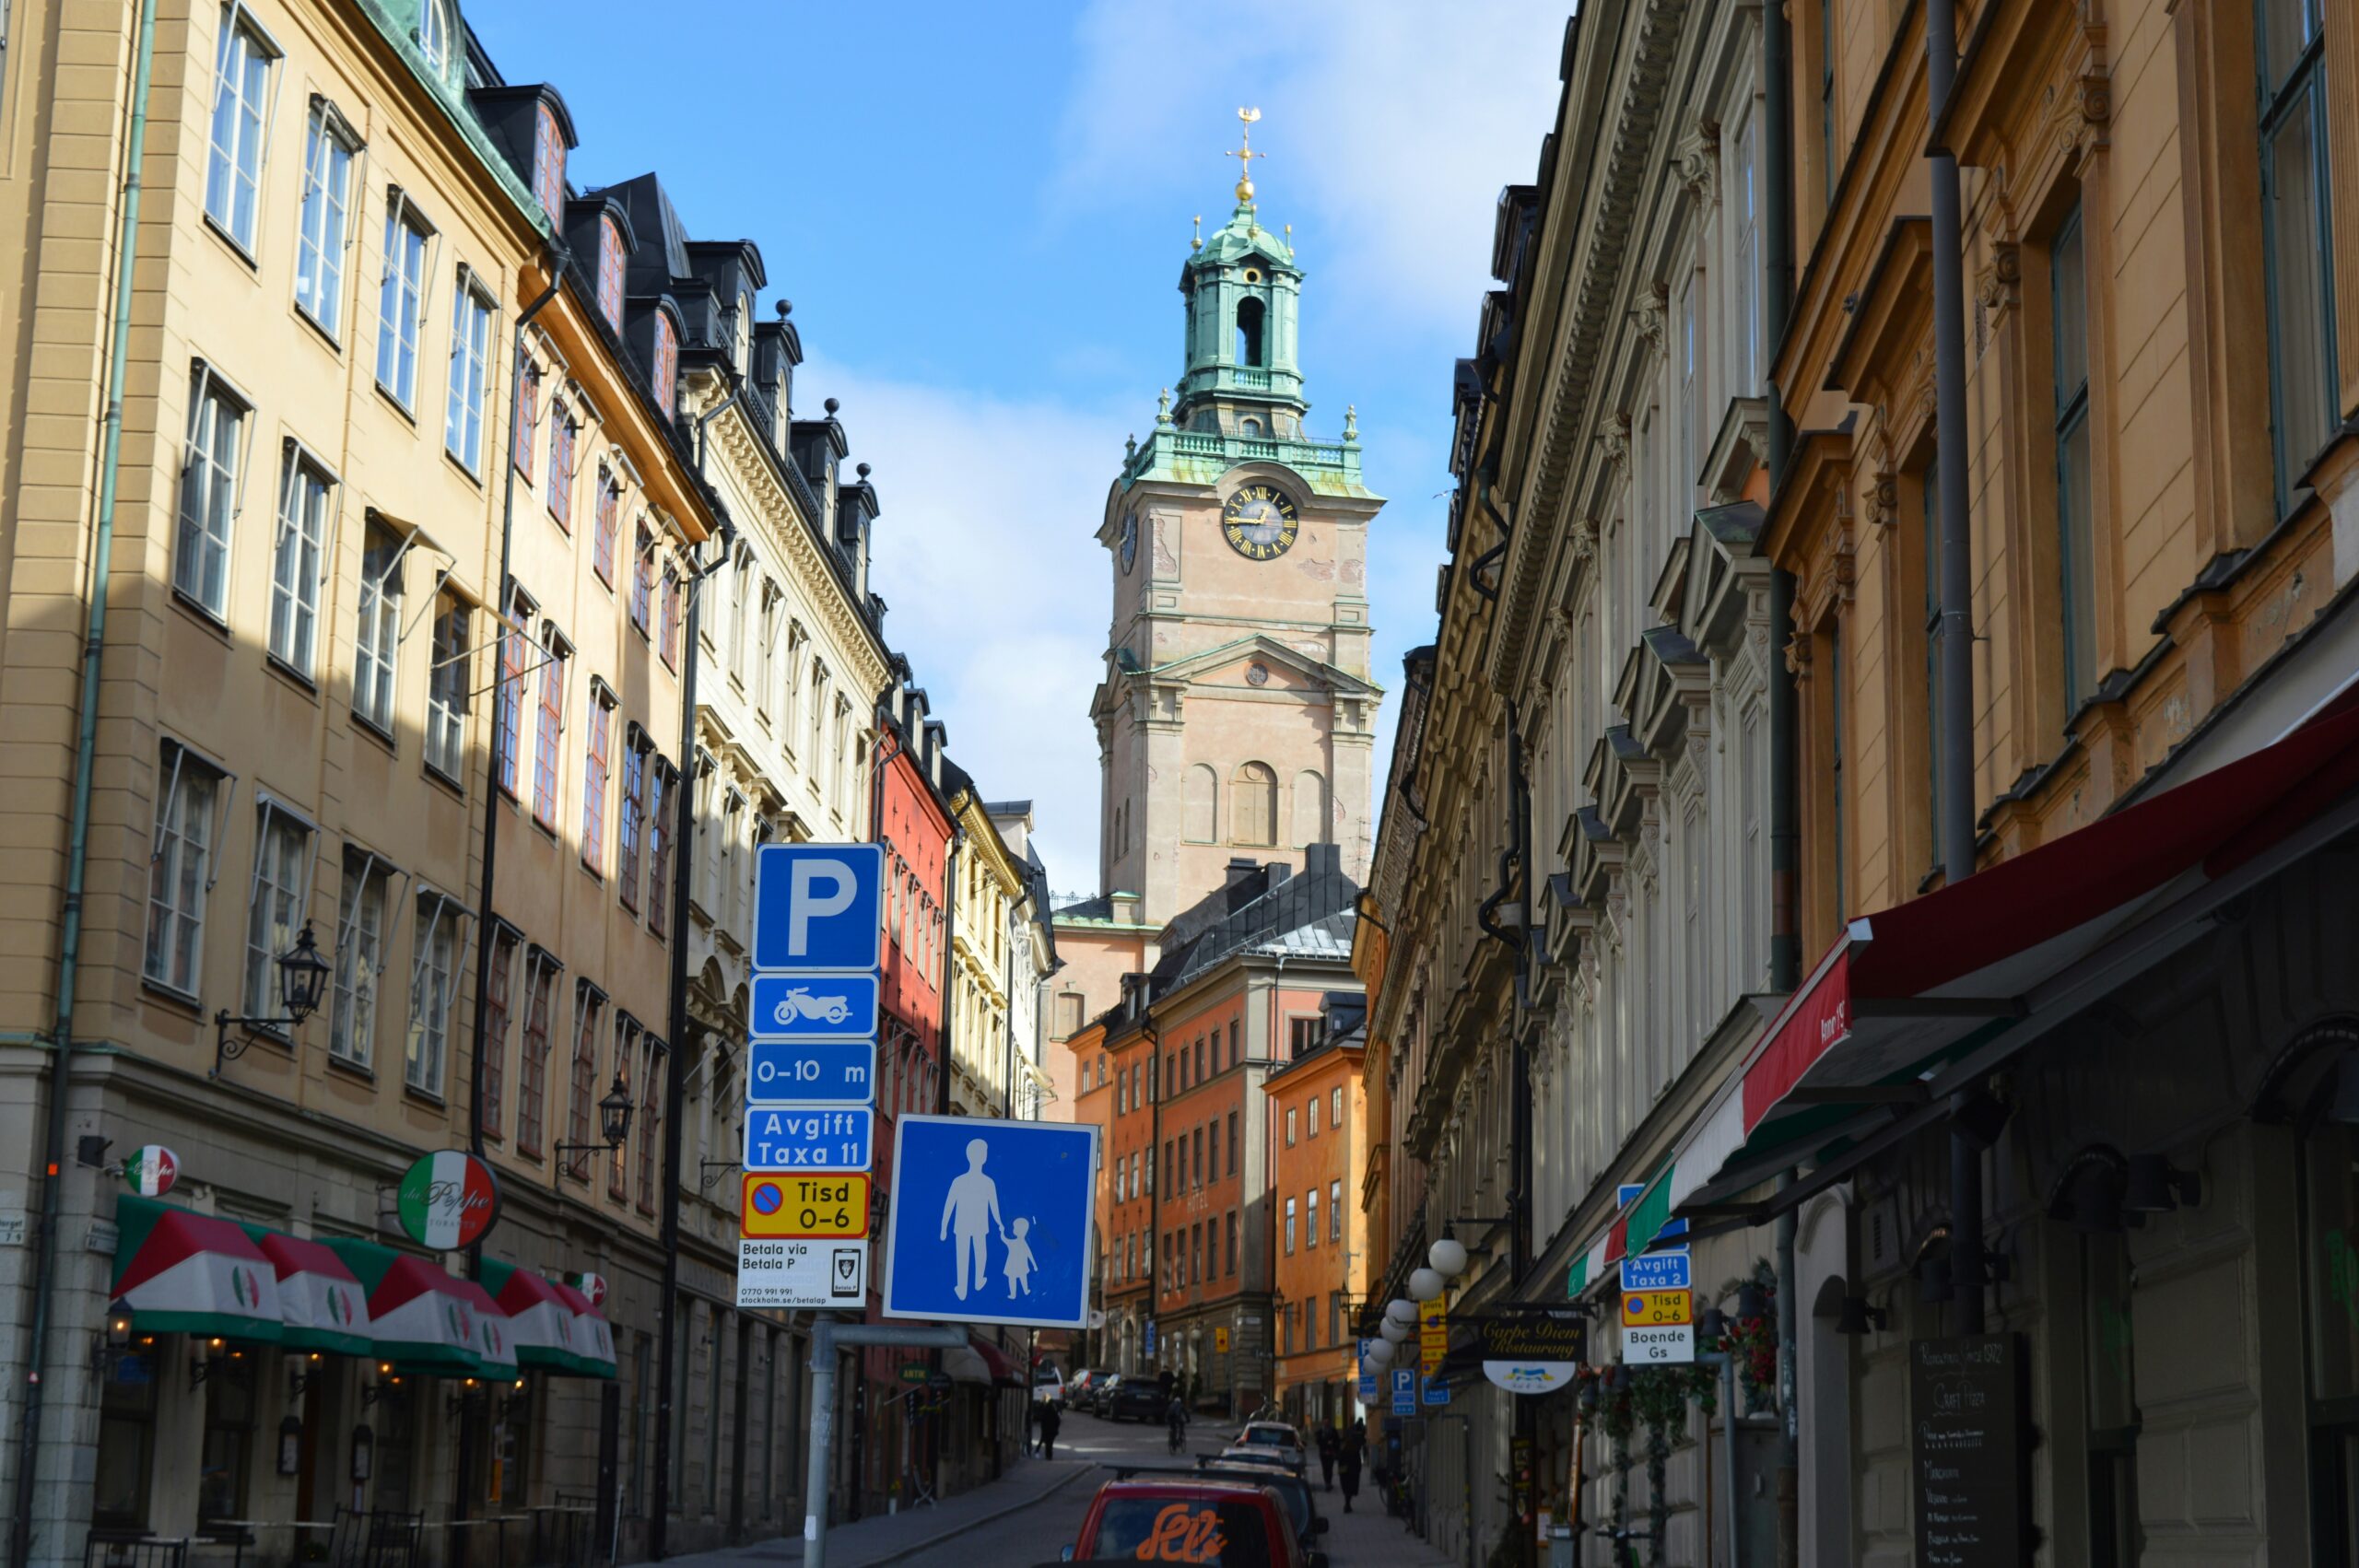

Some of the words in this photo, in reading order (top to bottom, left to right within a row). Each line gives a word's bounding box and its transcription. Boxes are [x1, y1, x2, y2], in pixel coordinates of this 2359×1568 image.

[1255, 486, 1267, 500] XII
[788, 859, 858, 956] P
[757, 1060, 820, 1082] 0-10
[844, 1066, 864, 1082] m
[764, 1113, 853, 1140] Avgift
[757, 1142, 827, 1164] Taxa
[841, 1142, 858, 1164] 11
[420, 1180, 489, 1217] Peppe
[798, 1182, 849, 1202] Tisd
[800, 1208, 850, 1229] 0-6
[743, 1244, 783, 1255] Betala
[788, 1244, 807, 1255] via
[742, 1258, 782, 1270] Betala
[787, 1258, 795, 1270] P
[1633, 1258, 1678, 1273] Avgift
[1630, 1274, 1666, 1287] Taxa
[1672, 1273, 1682, 1285] 2
[741, 1296, 827, 1305] stockholm.se/betalap
[1651, 1294, 1681, 1306] Tisd
[1653, 1310, 1681, 1322] 0-6
[1483, 1319, 1530, 1341] Carpe
[1535, 1320, 1579, 1340] Diem
[1630, 1330, 1684, 1344] Boende
[1489, 1339, 1575, 1360] Restaurang
[1649, 1347, 1667, 1359] Gs
[903, 1369, 926, 1379] ANTIK
[1398, 1373, 1410, 1389] P
